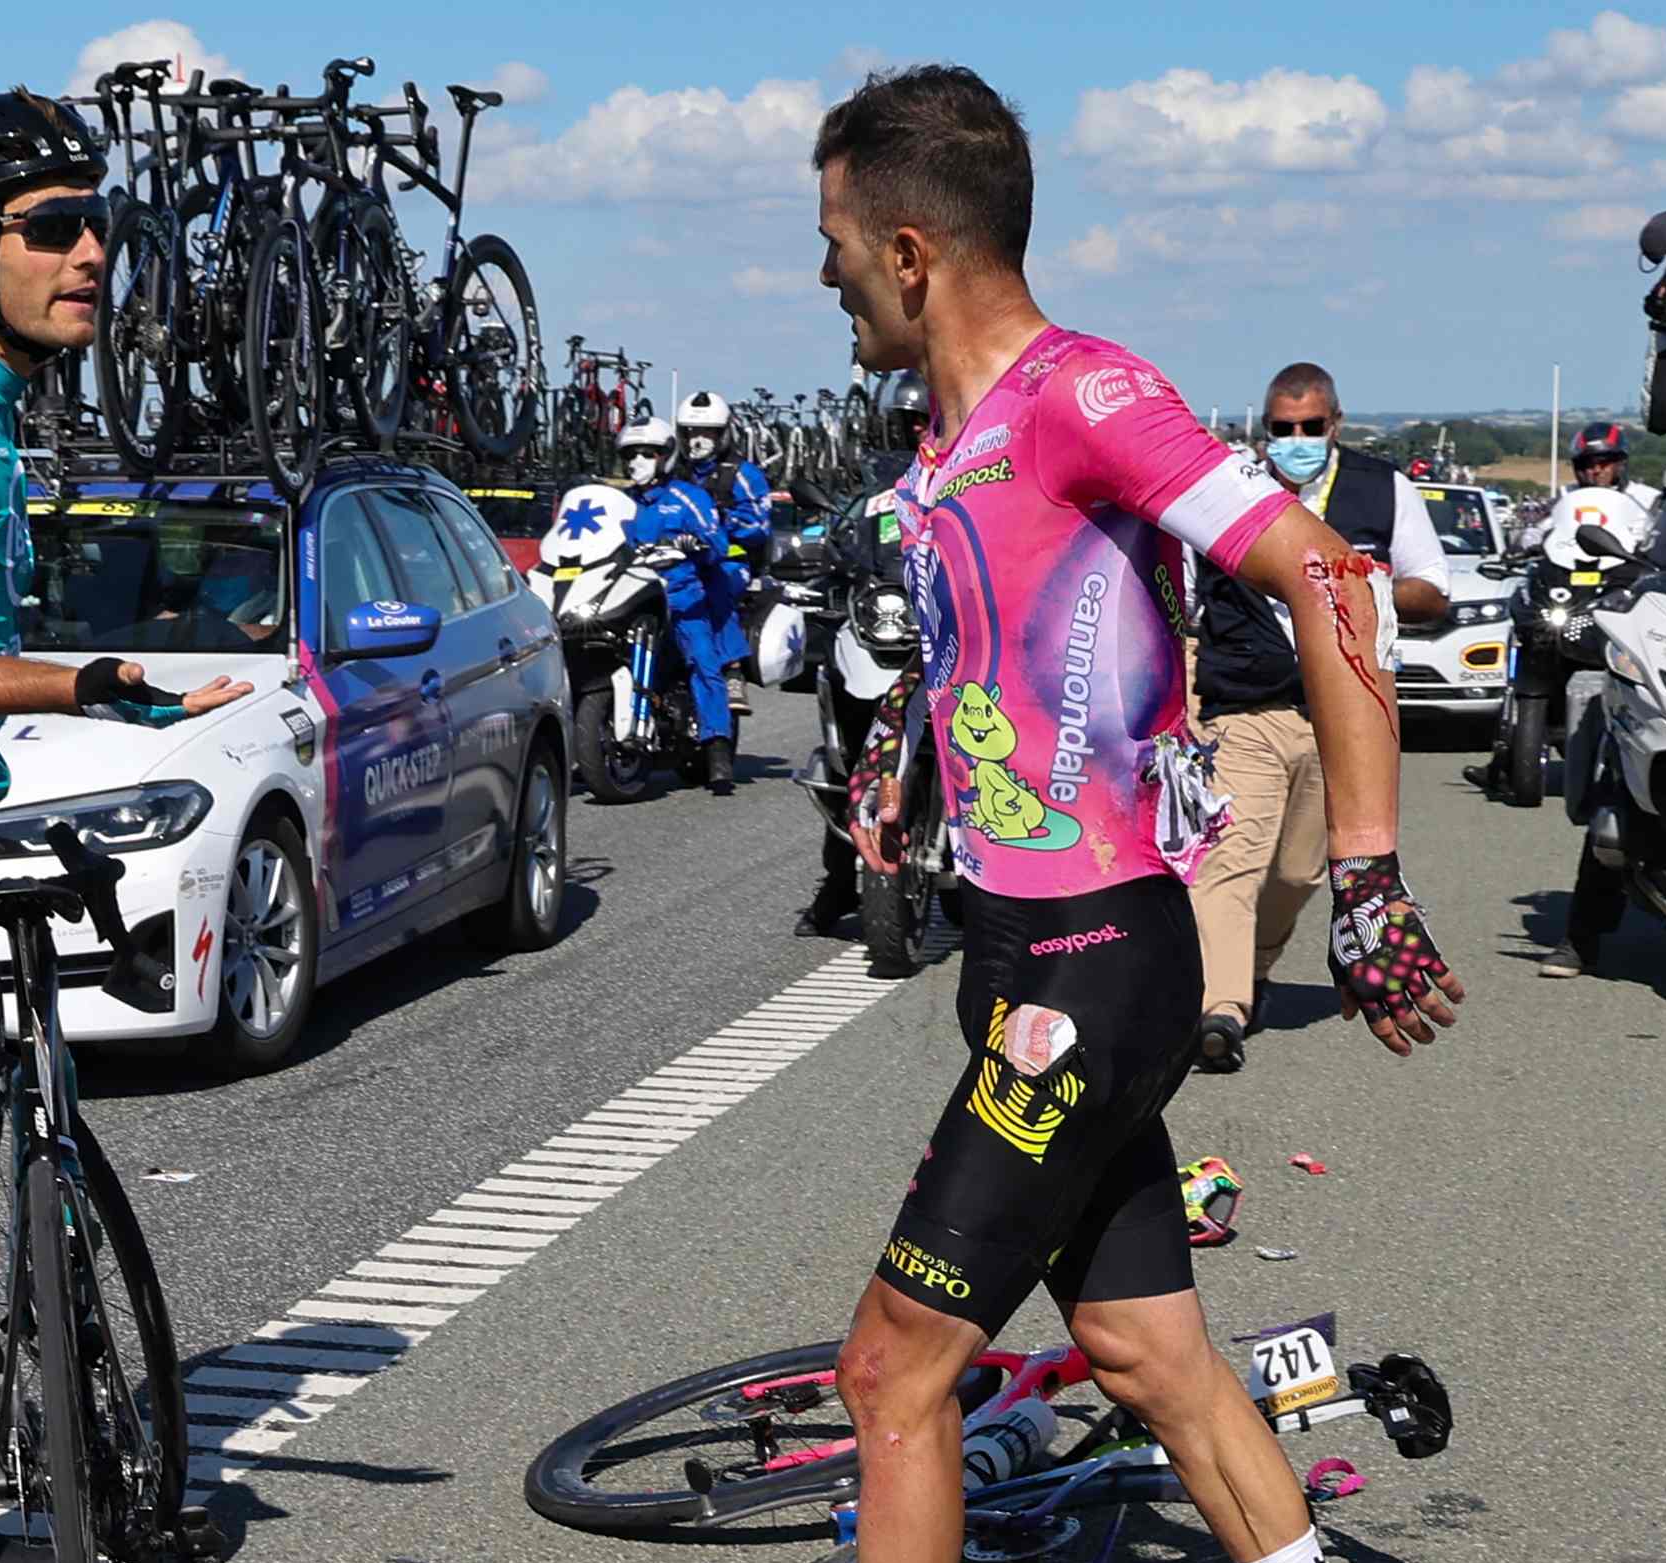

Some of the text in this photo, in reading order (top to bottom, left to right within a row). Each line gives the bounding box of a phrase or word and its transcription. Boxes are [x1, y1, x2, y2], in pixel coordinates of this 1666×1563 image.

[935, 456, 1016, 502] asypost.
[1048, 570, 1109, 805] cannondale
[953, 845, 983, 878] ACE
[1029, 922, 1129, 957] easypost.
[886, 1242, 972, 1300] NIPPO
[1255, 1332, 1322, 1387] 142
